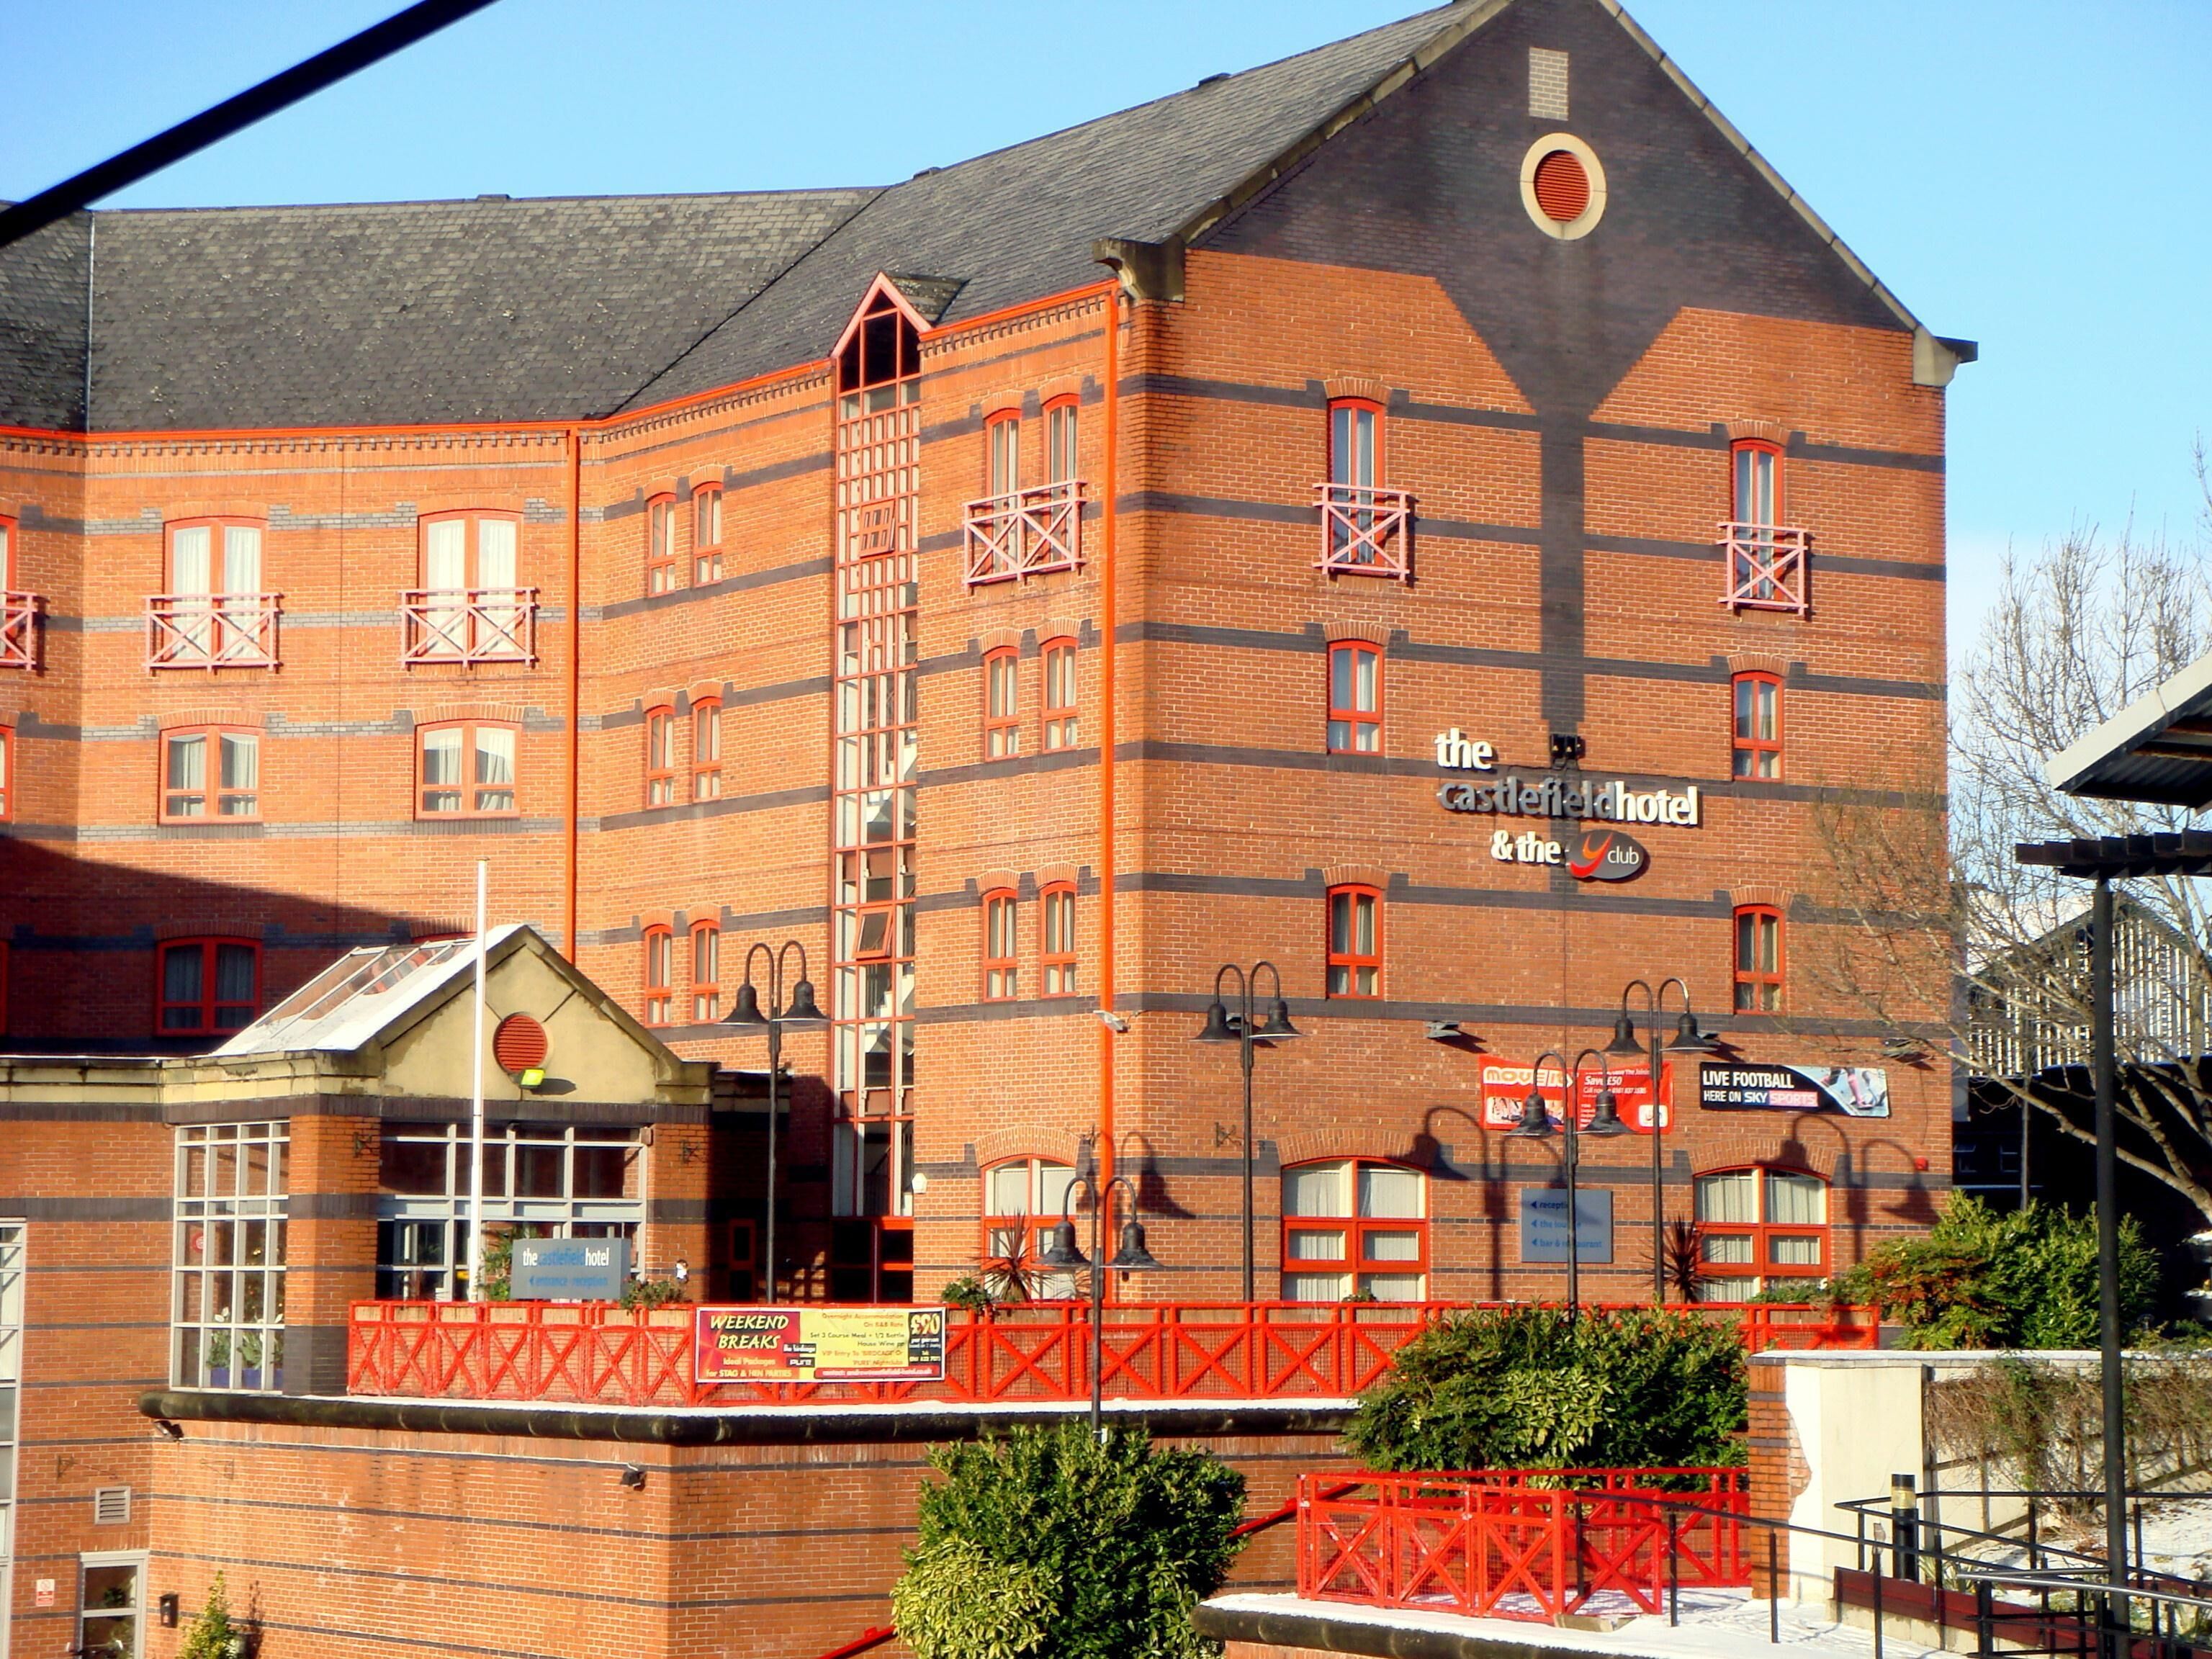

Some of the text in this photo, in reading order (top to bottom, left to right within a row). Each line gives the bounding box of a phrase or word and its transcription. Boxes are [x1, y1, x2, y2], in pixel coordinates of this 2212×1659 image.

[1434, 727, 1493, 770] the
[1491, 830, 1514, 860] &
[1516, 831, 1561, 864] the
[1607, 845, 1640, 865] club
[1703, 1071, 1794, 1089] LIVE FOOTBALL
[1703, 1090, 1817, 1106] HERE ON SKY SPORTS
[523, 1247, 538, 1267] the
[585, 1246, 610, 1267] hotel
[710, 1315, 789, 1330] WEEKEND
[910, 1313, 940, 1335] £90
[719, 1334, 781, 1349] BREAKS
[723, 1357, 742, 1366] Ideal
